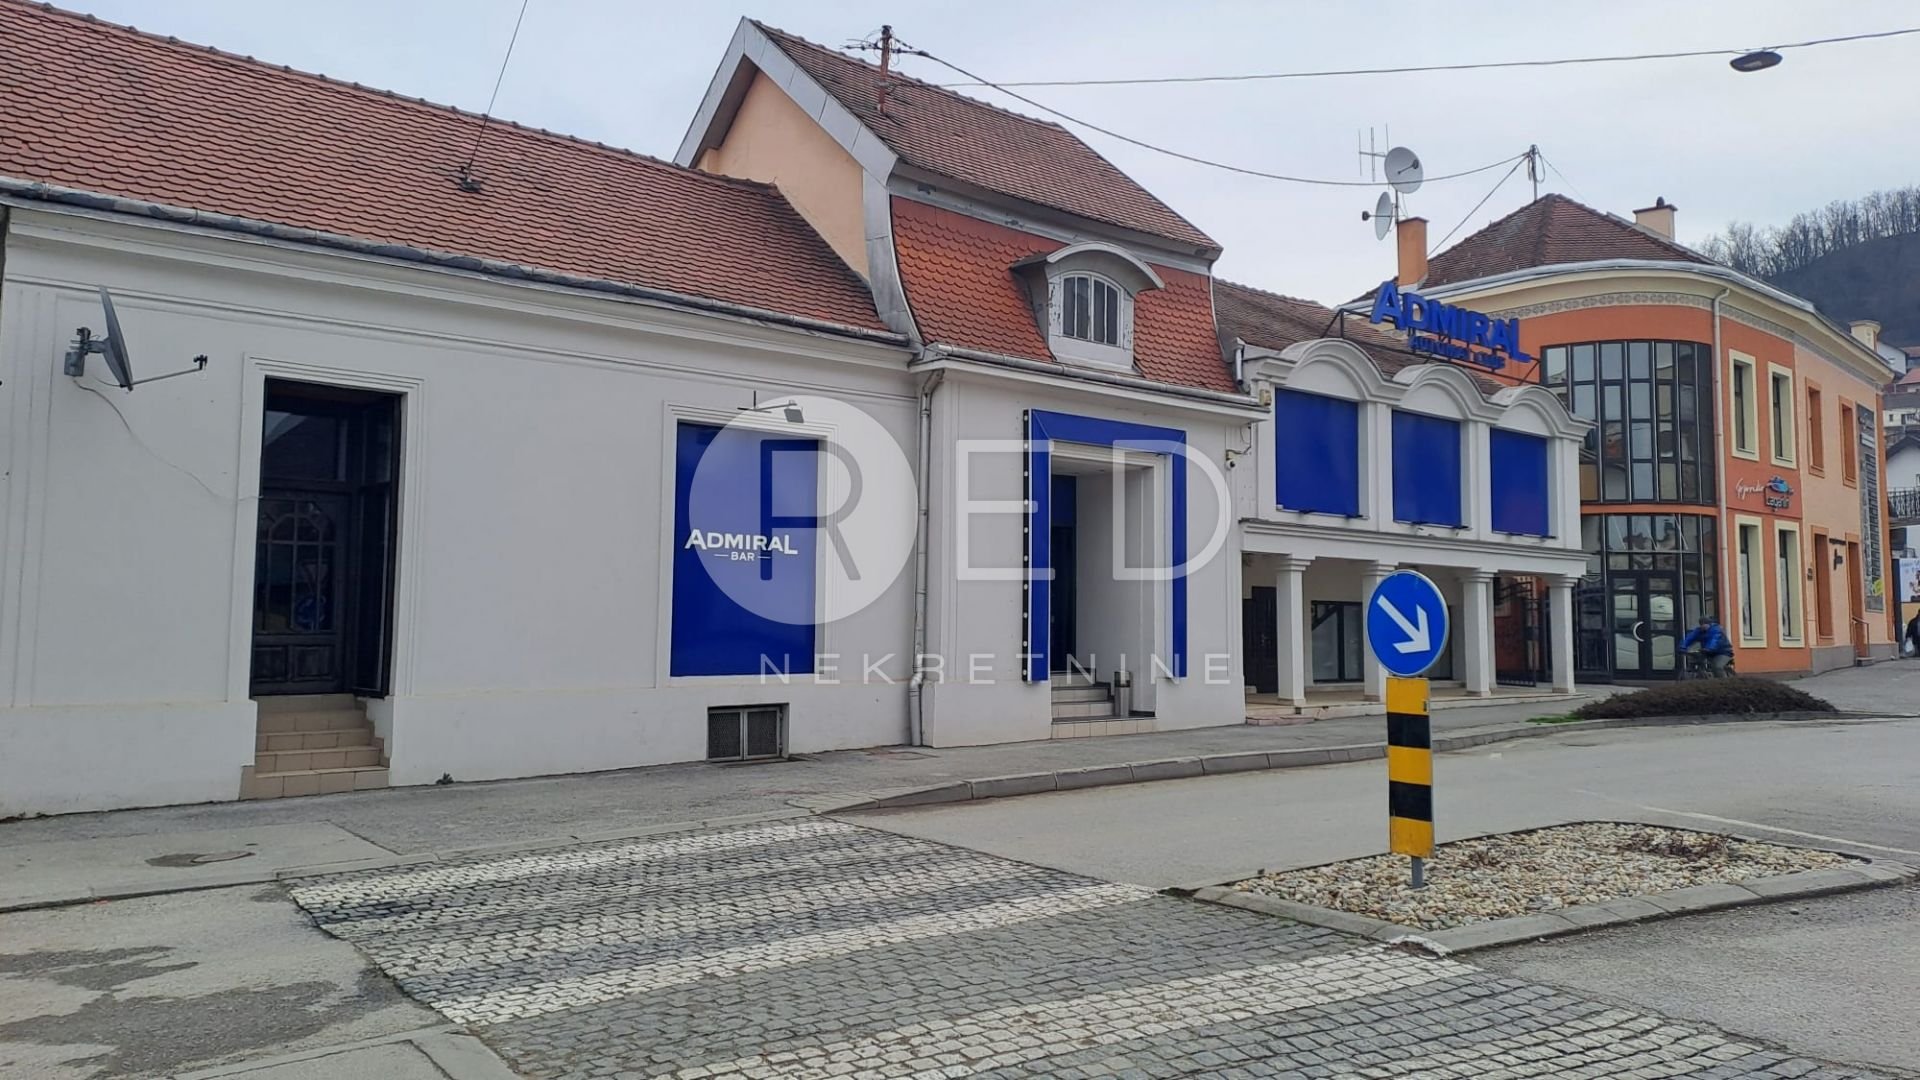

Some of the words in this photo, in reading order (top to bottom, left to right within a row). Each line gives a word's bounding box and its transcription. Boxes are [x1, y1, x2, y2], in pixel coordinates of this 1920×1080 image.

[1369, 281, 1532, 363] ADMIRAL
[684, 528, 799, 555] ADMIRAL
[730, 551, 755, 561] BAR
